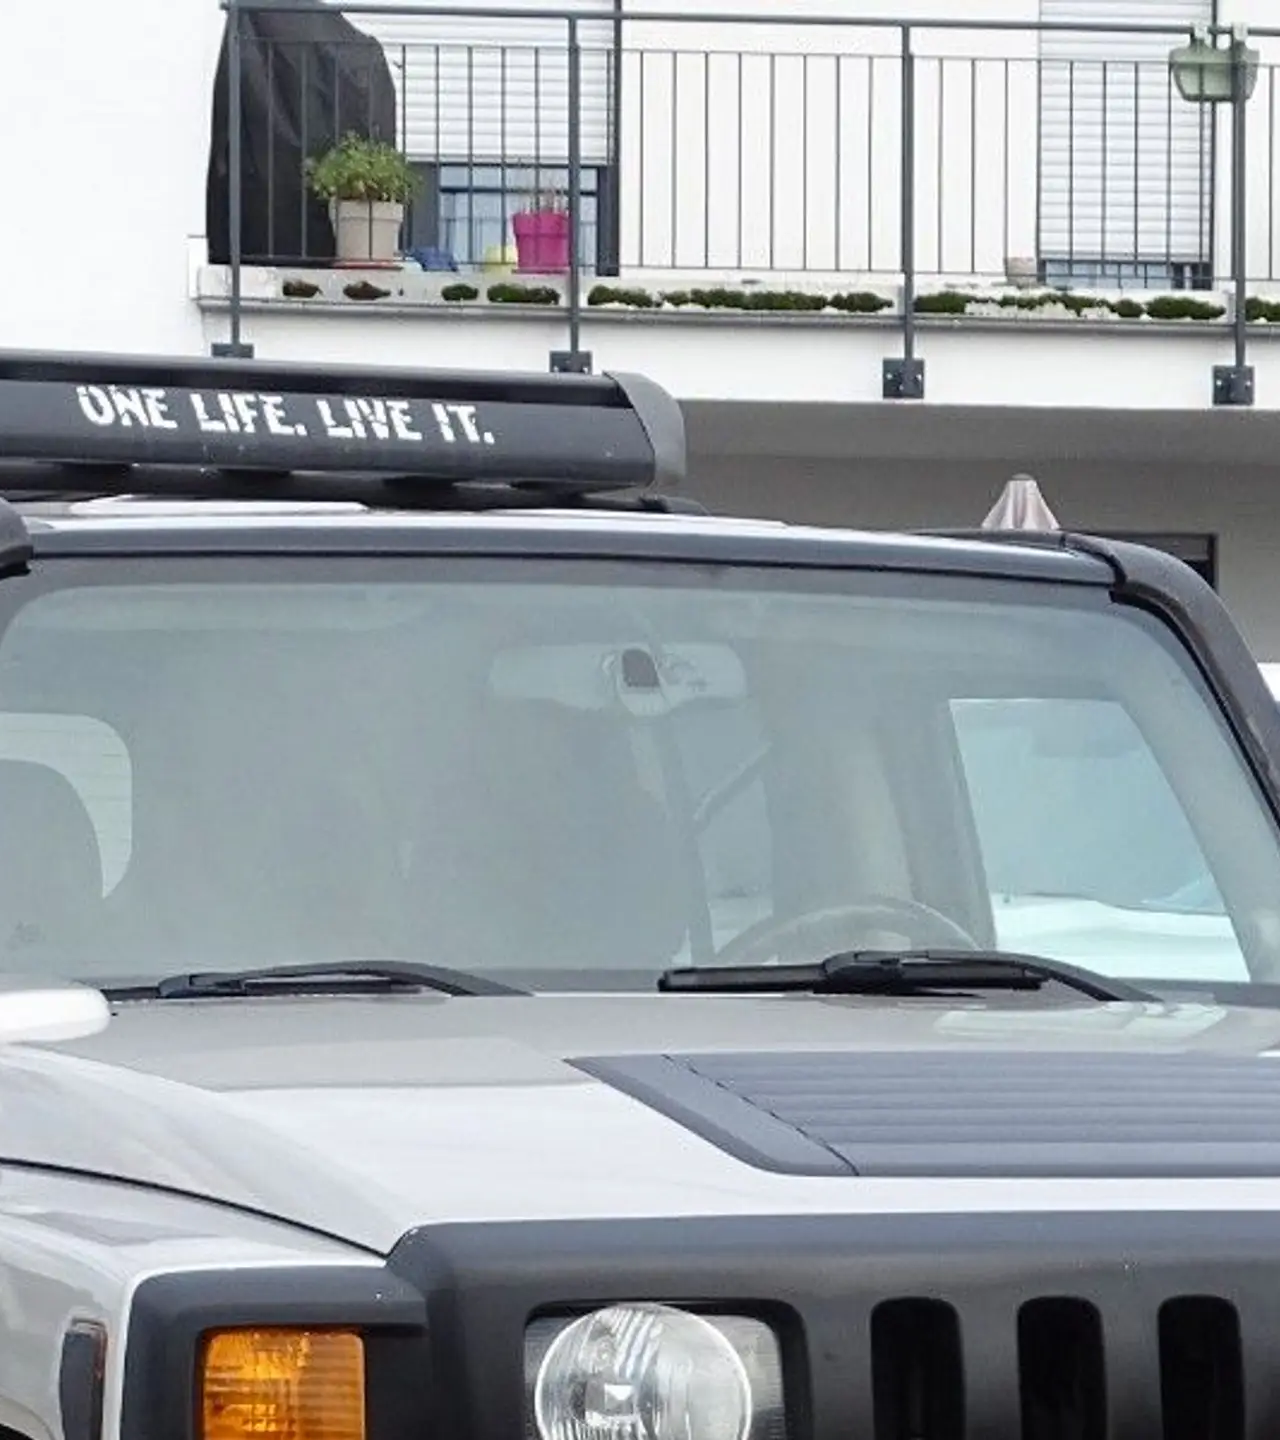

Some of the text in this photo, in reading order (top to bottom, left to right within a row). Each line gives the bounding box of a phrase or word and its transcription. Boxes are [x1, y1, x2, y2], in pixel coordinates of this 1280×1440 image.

[76, 384, 496, 445] ONE LIFE. LIVE IT.
